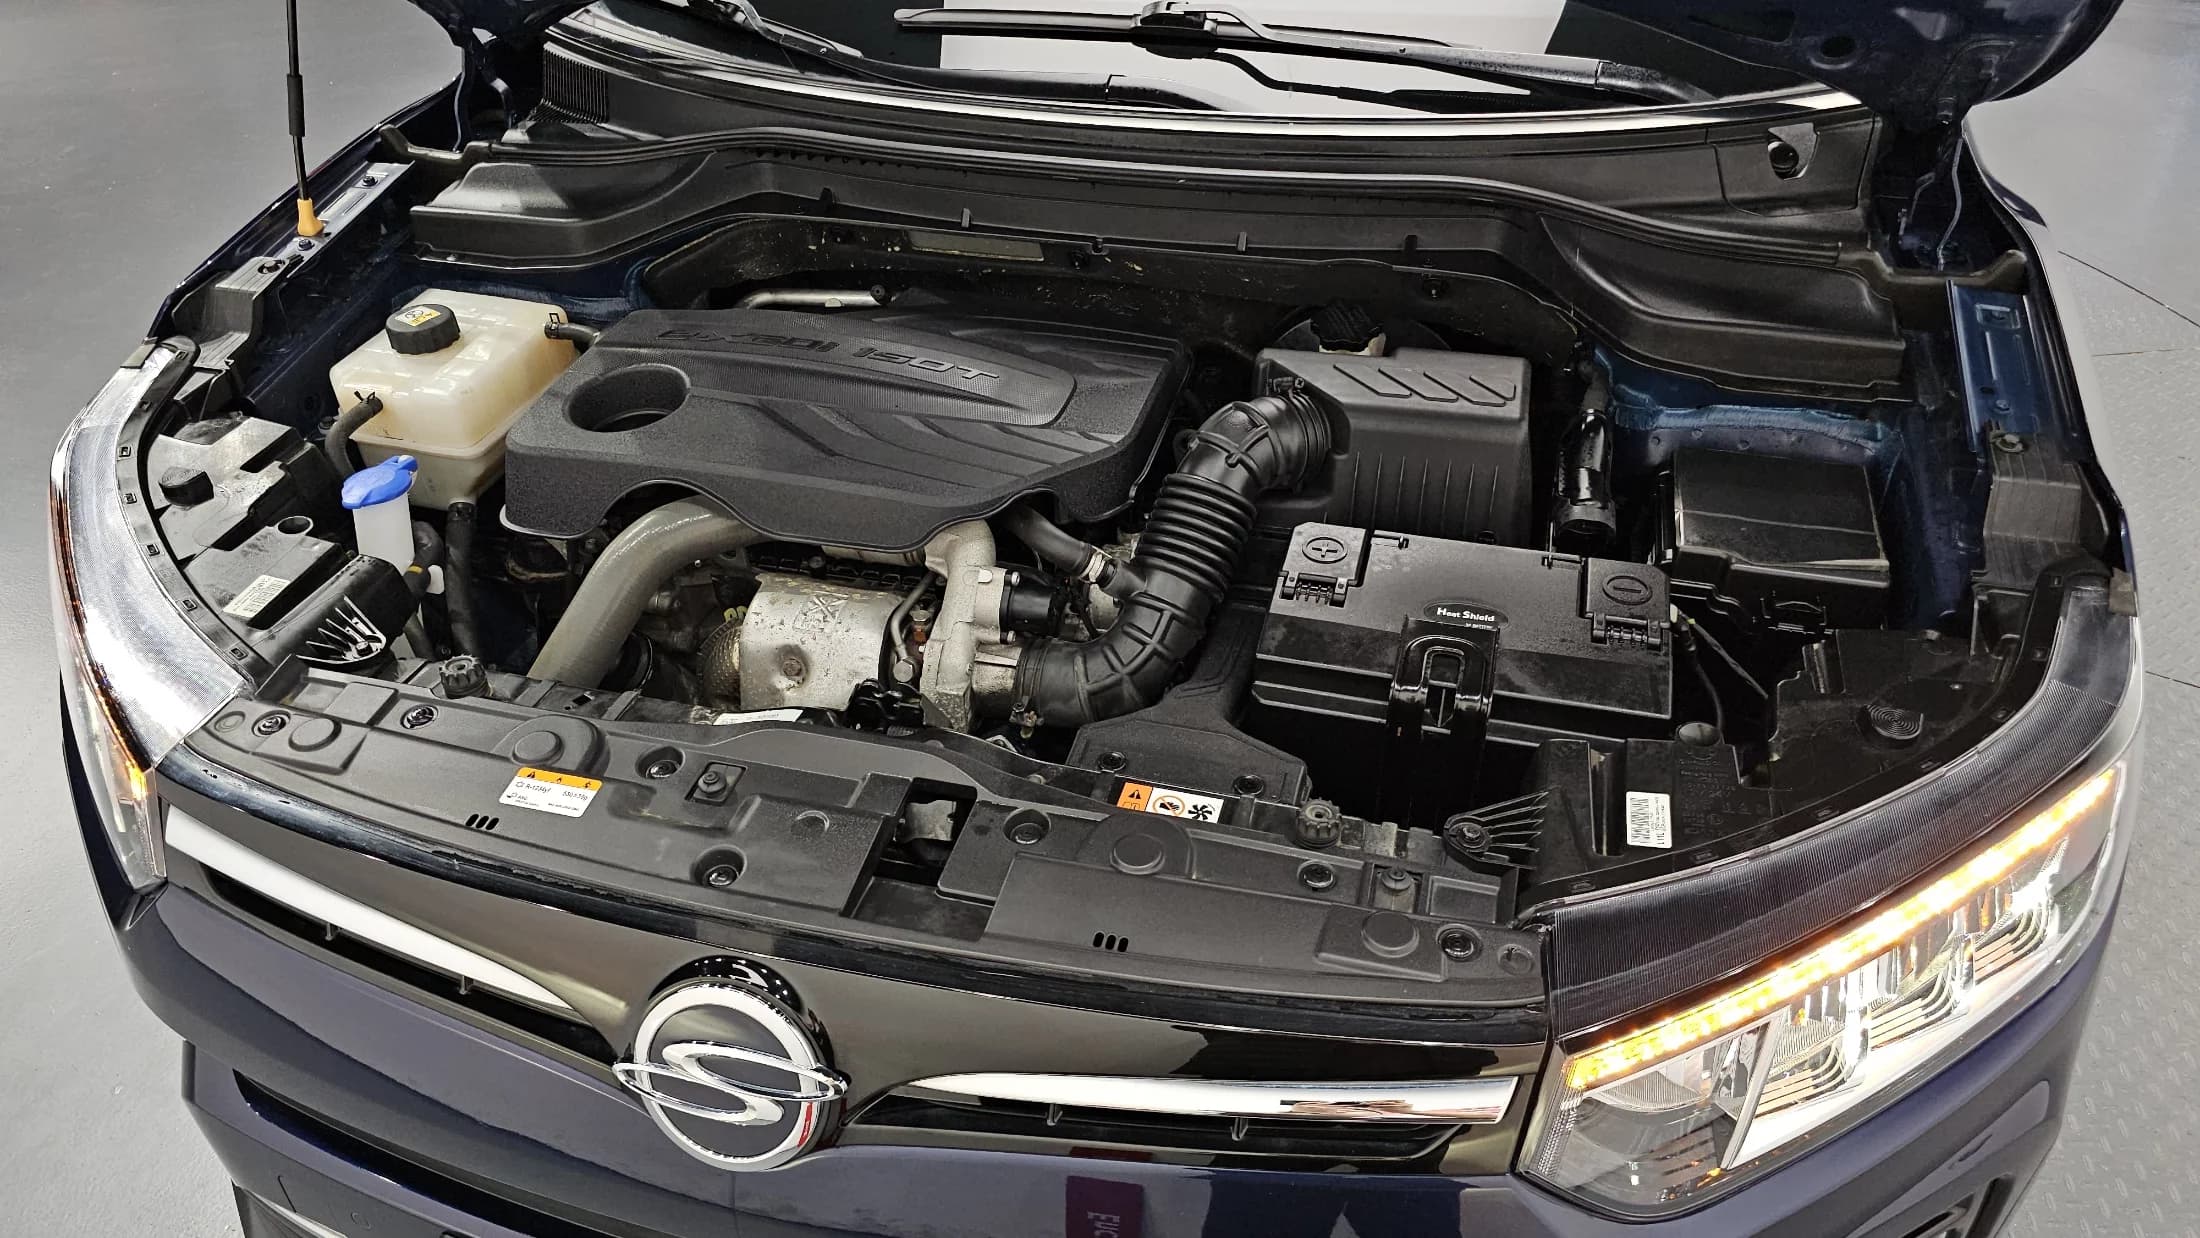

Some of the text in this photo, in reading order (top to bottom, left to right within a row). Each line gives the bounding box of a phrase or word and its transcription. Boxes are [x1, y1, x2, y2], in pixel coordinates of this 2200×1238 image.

[853, 348, 1000, 379] 150T
[1436, 607, 1495, 622] Heat Shield
